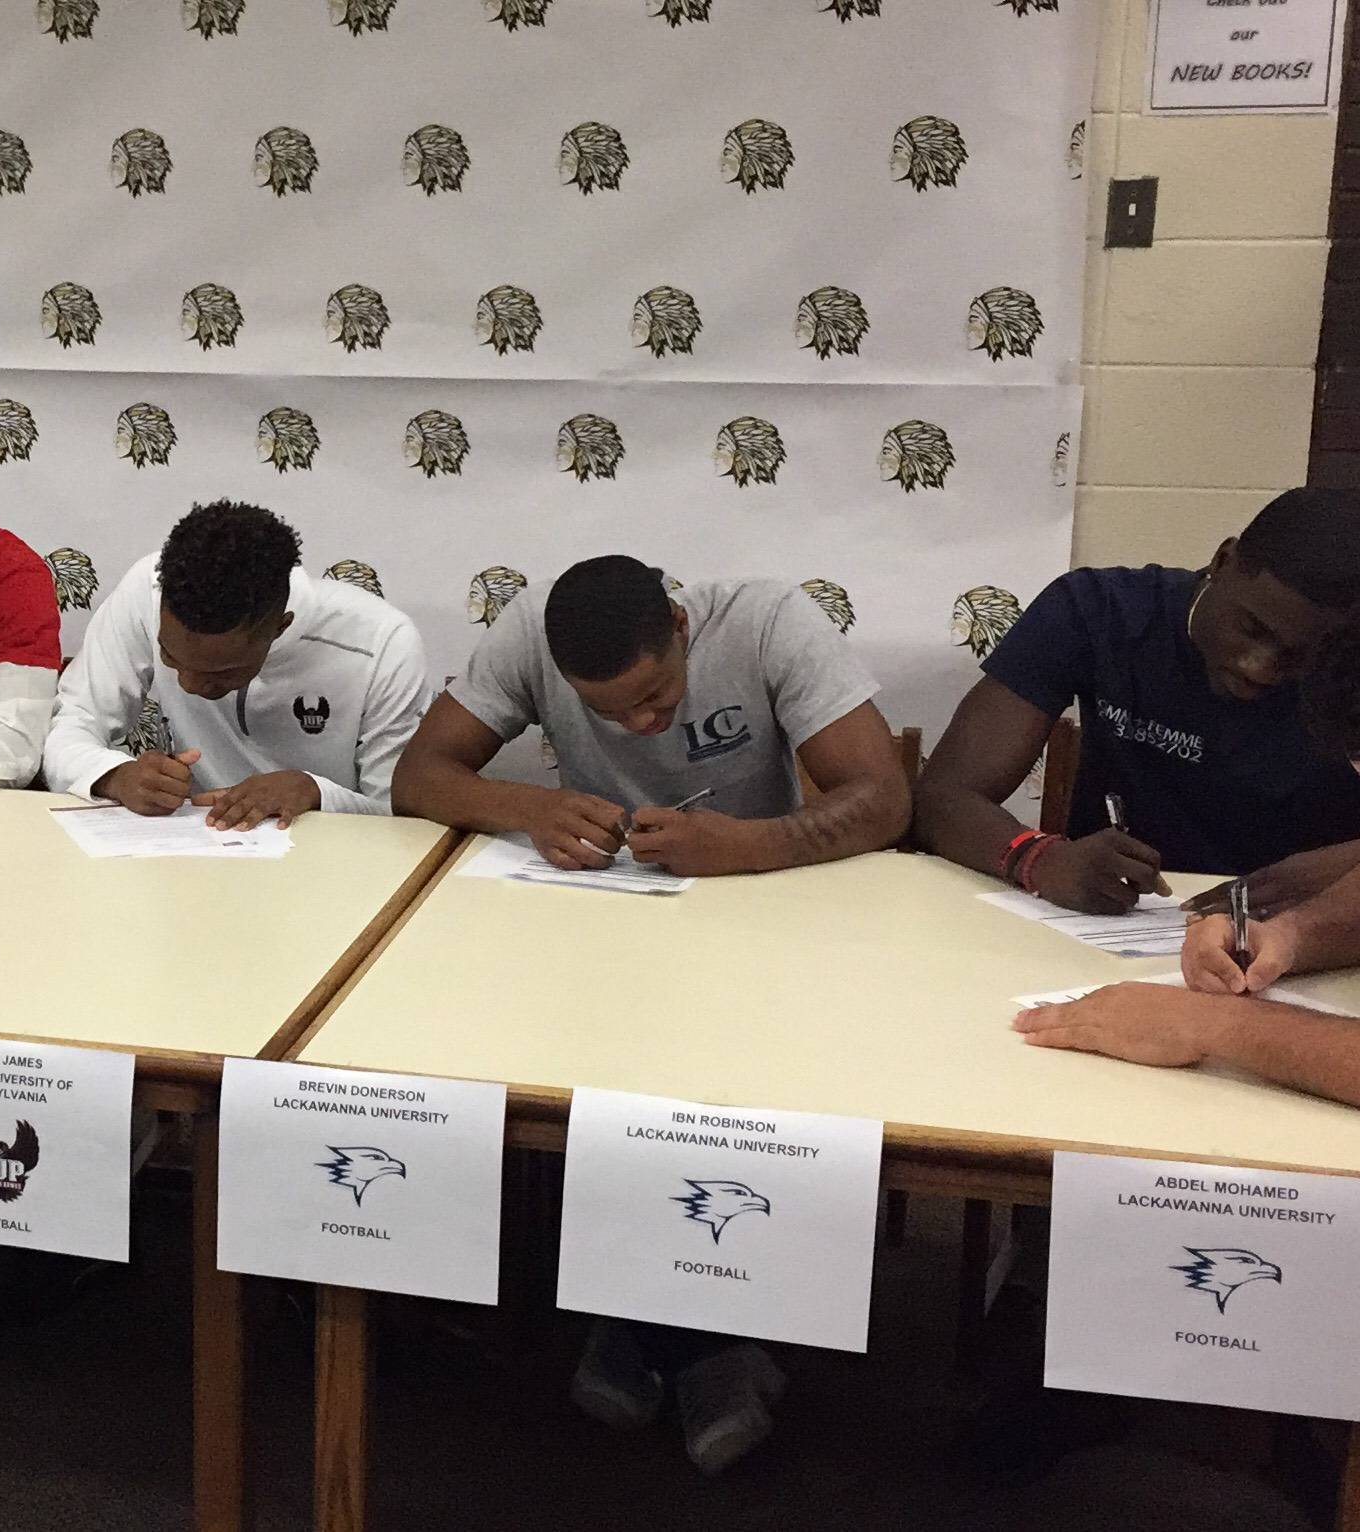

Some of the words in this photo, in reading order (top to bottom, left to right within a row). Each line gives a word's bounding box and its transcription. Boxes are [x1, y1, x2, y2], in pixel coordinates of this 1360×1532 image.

[1230, 30, 1259, 41] our
[1170, 63, 1223, 82] NEW
[1231, 61, 1313, 82] BOOKS!
[680, 705, 748, 752] LC
[2, 1055, 43, 1069] JAMES
[57, 1079, 73, 1091] OF
[299, 1080, 347, 1095] BREVIN
[350, 1085, 425, 1103] DONERSON
[274, 1097, 367, 1116] LACKAWANNA
[370, 1107, 449, 1125] UNIVERSITY
[672, 1112, 696, 1124] IBN
[700, 1115, 776, 1134] ROBINSON
[626, 1126, 729, 1148] LACKAWANNA
[733, 1138, 820, 1159] UNIVERSITY
[1155, 1176, 1209, 1192] ABDEL
[1214, 1181, 1299, 1200] MOHAMED
[1118, 1193, 1234, 1215] LACKAWANNA
[1239, 1205, 1337, 1225] UNIVERSITY
[322, 1222, 391, 1240] FOOTBALL
[674, 1260, 751, 1281] FOOTBALL
[1175, 1331, 1261, 1352] FOOTBALL
